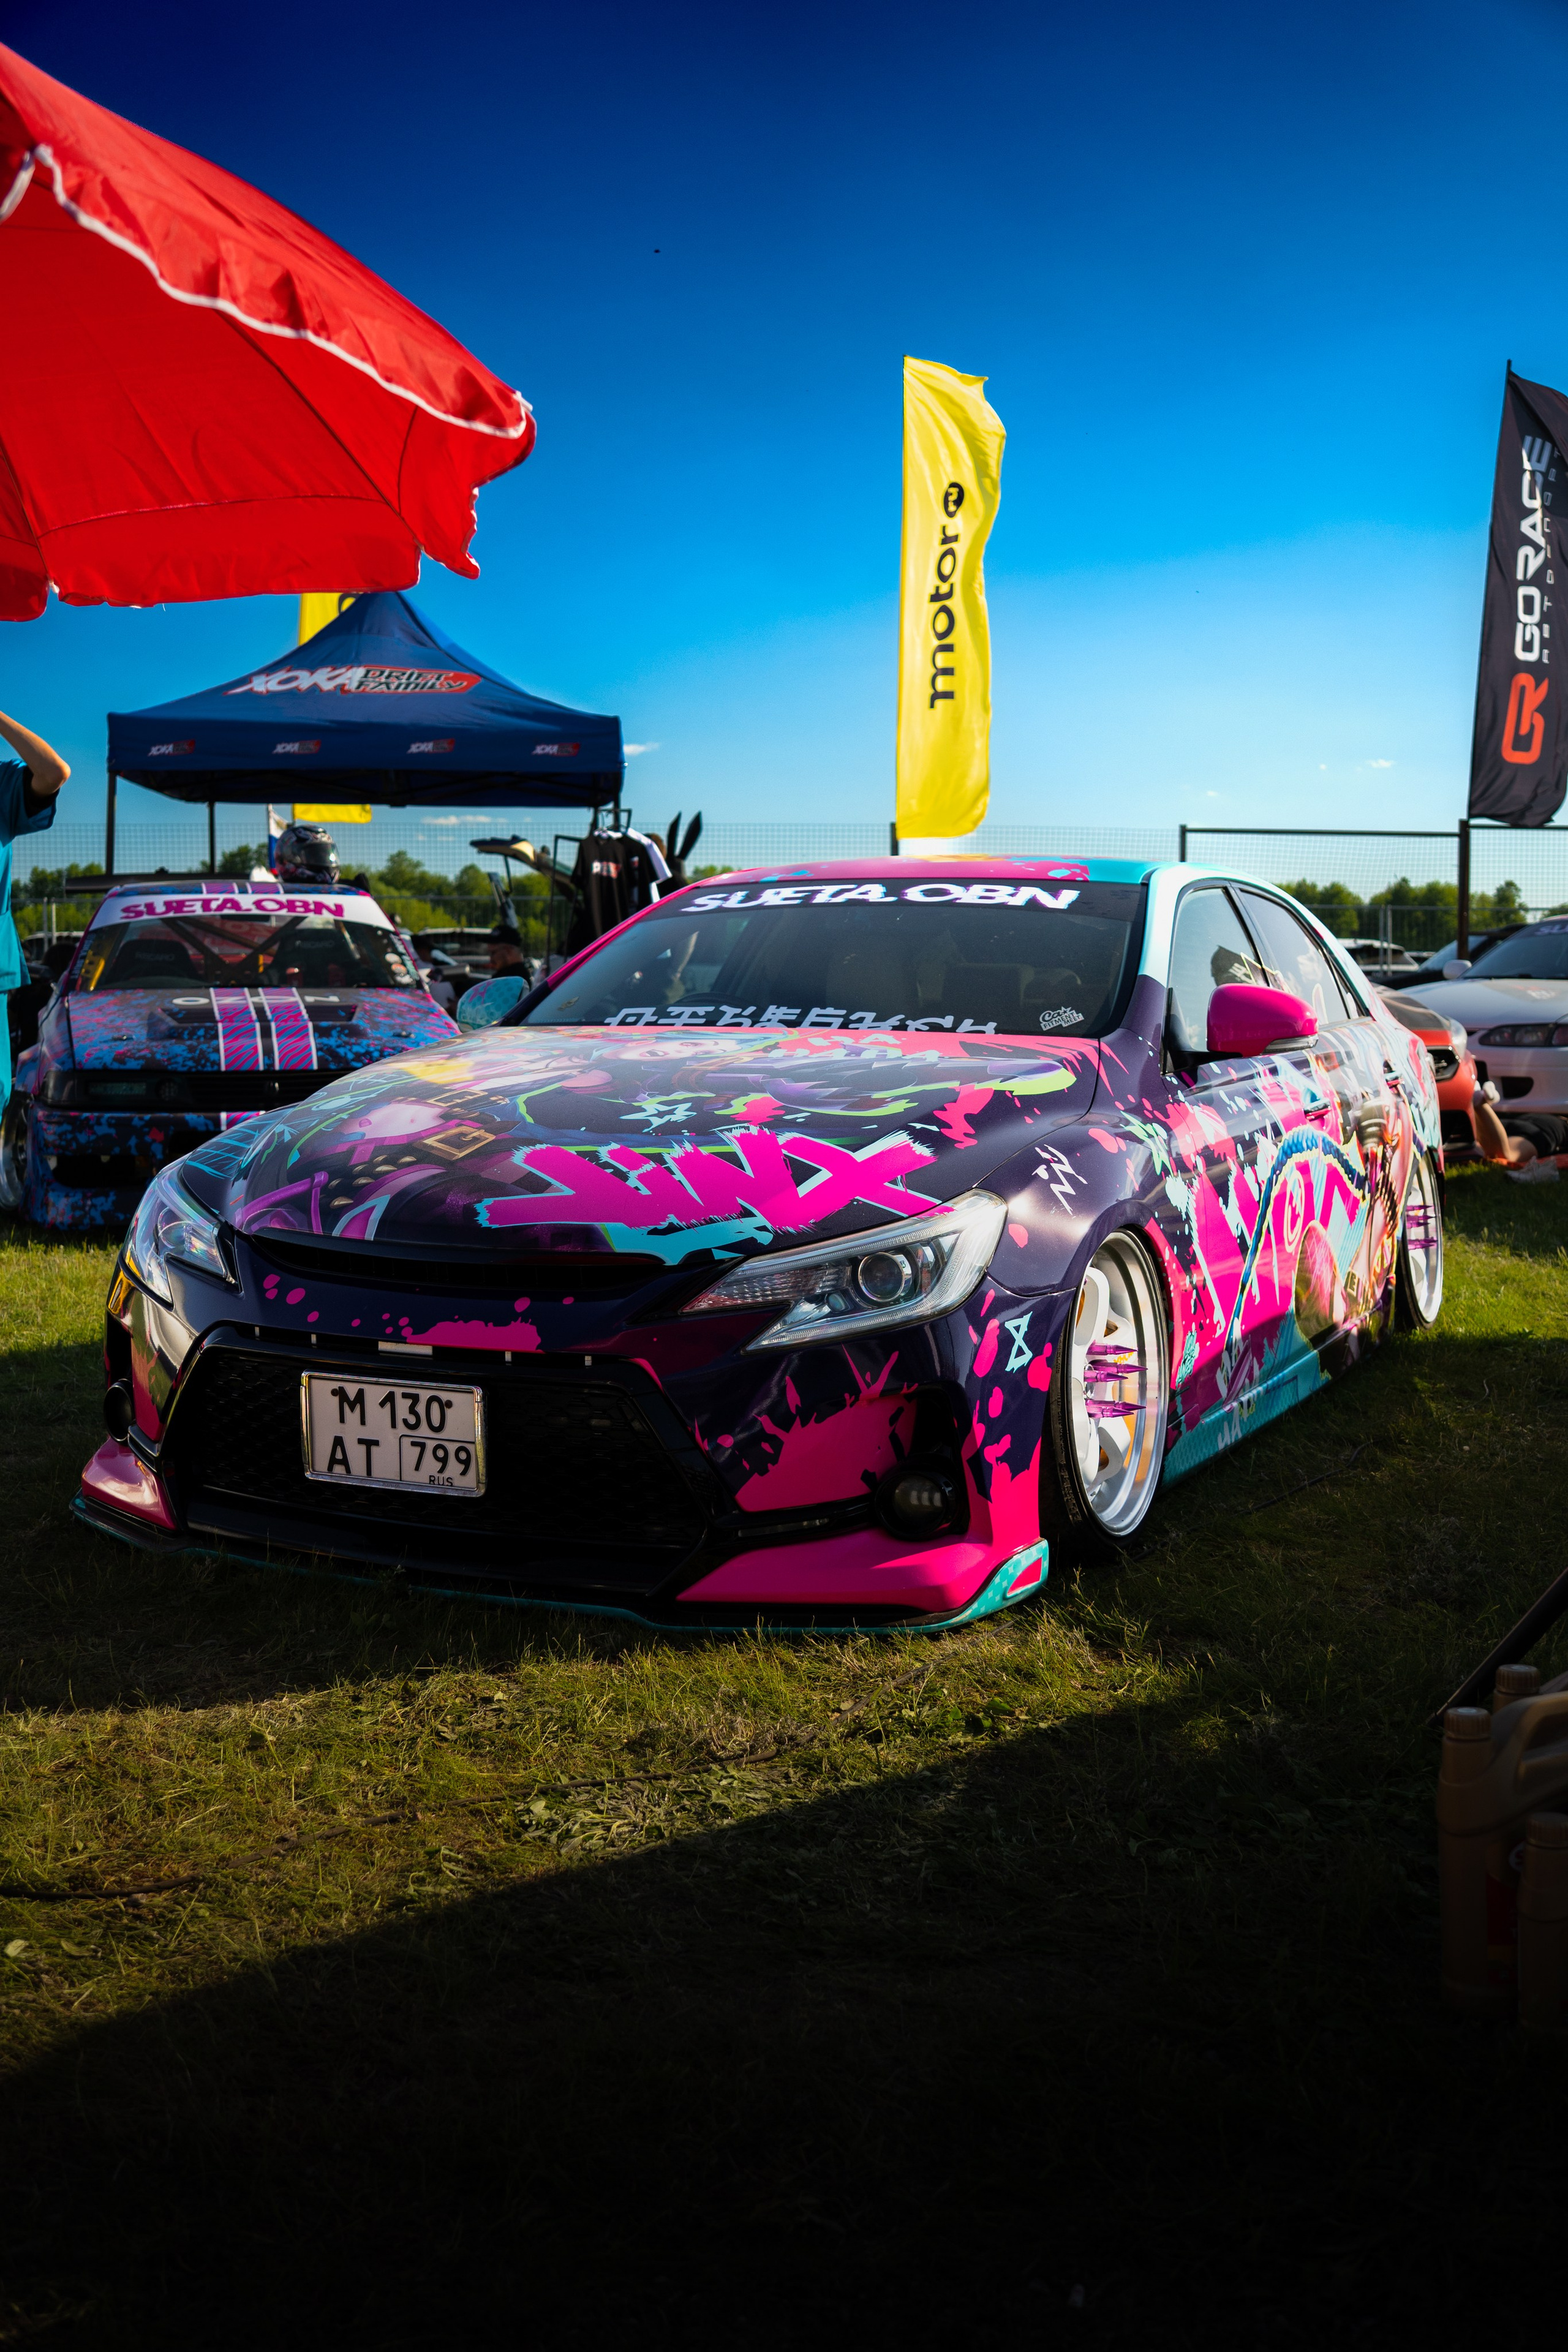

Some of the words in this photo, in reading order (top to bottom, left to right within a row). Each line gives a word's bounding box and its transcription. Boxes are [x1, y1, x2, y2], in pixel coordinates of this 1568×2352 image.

[929, 525, 959, 709] motor
[363, 668, 454, 680] DRIFT
[1043, 1012, 1076, 1028] FITMENT
[1064, 1016, 1082, 1025] MEET
[410, 1441, 472, 1476] 799
[429, 1475, 453, 1487] RUS
